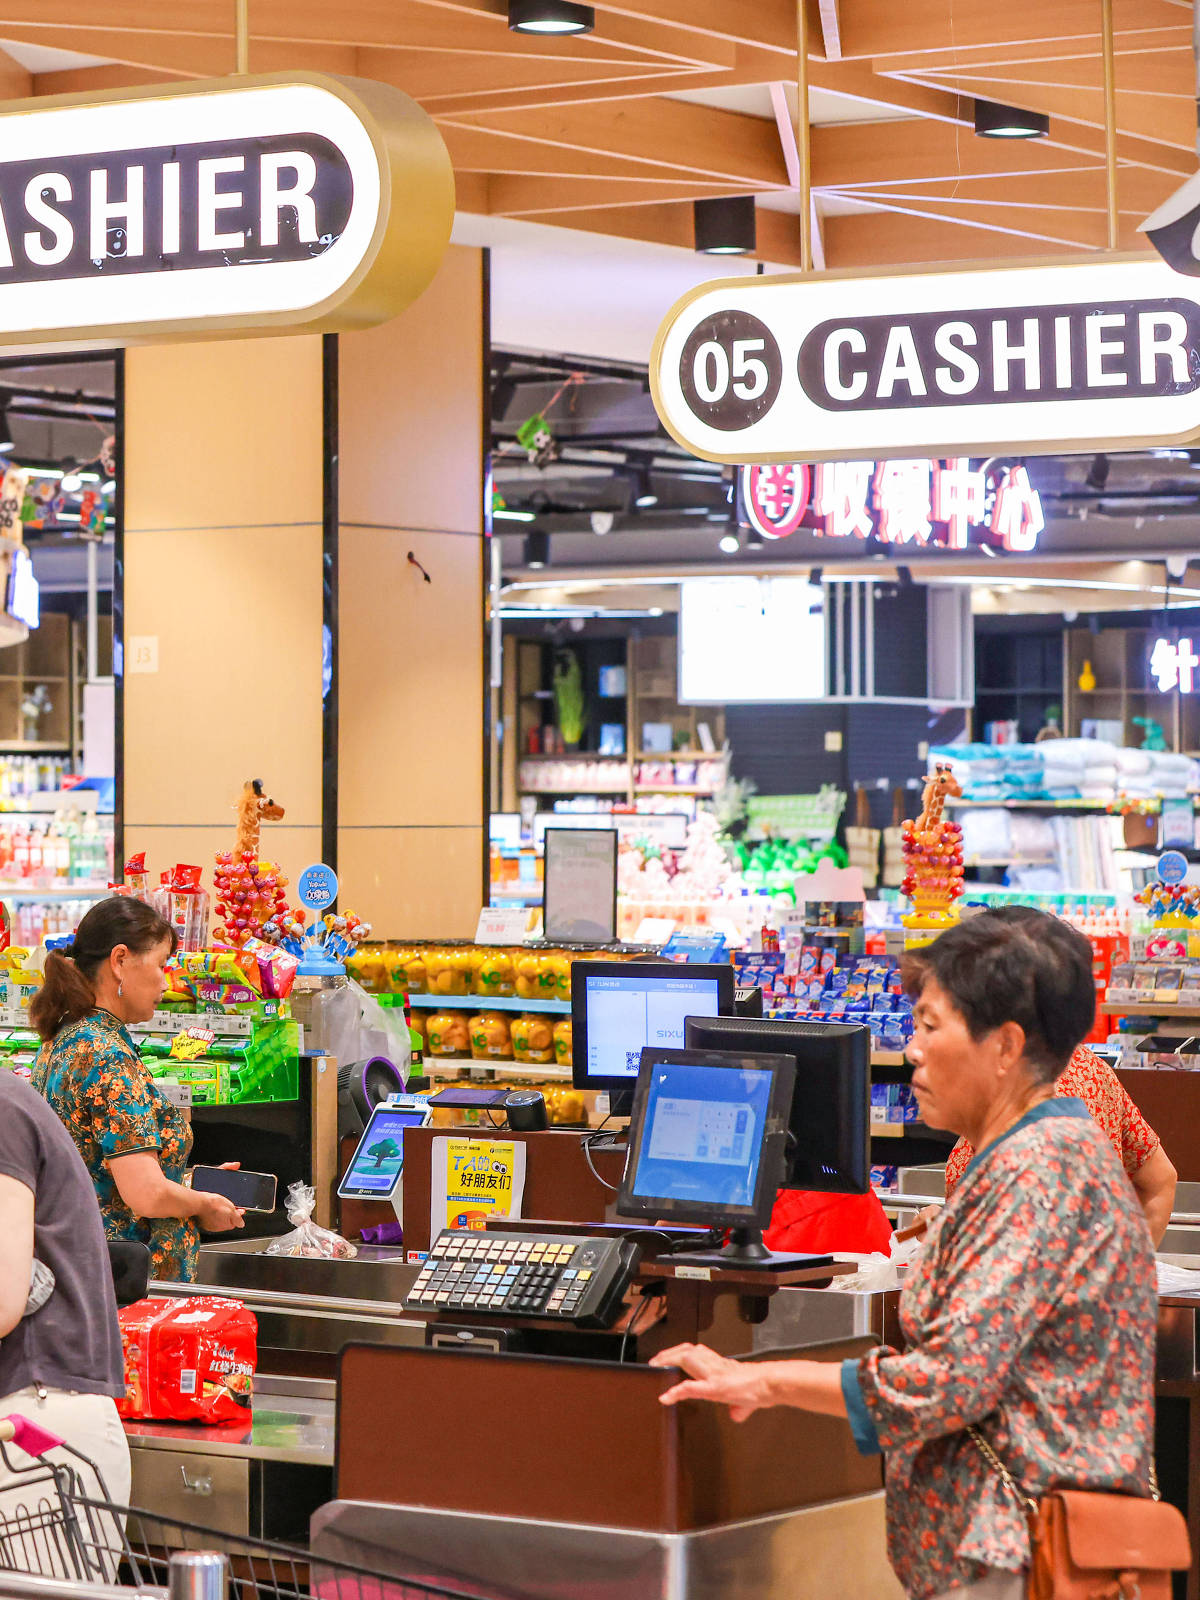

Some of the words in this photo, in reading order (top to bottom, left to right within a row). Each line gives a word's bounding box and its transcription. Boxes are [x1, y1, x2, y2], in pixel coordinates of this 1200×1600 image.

[693, 338, 769, 403] 05
[824, 311, 1191, 401] CASHIER
[460, 1172, 512, 1190] 好朋友们
